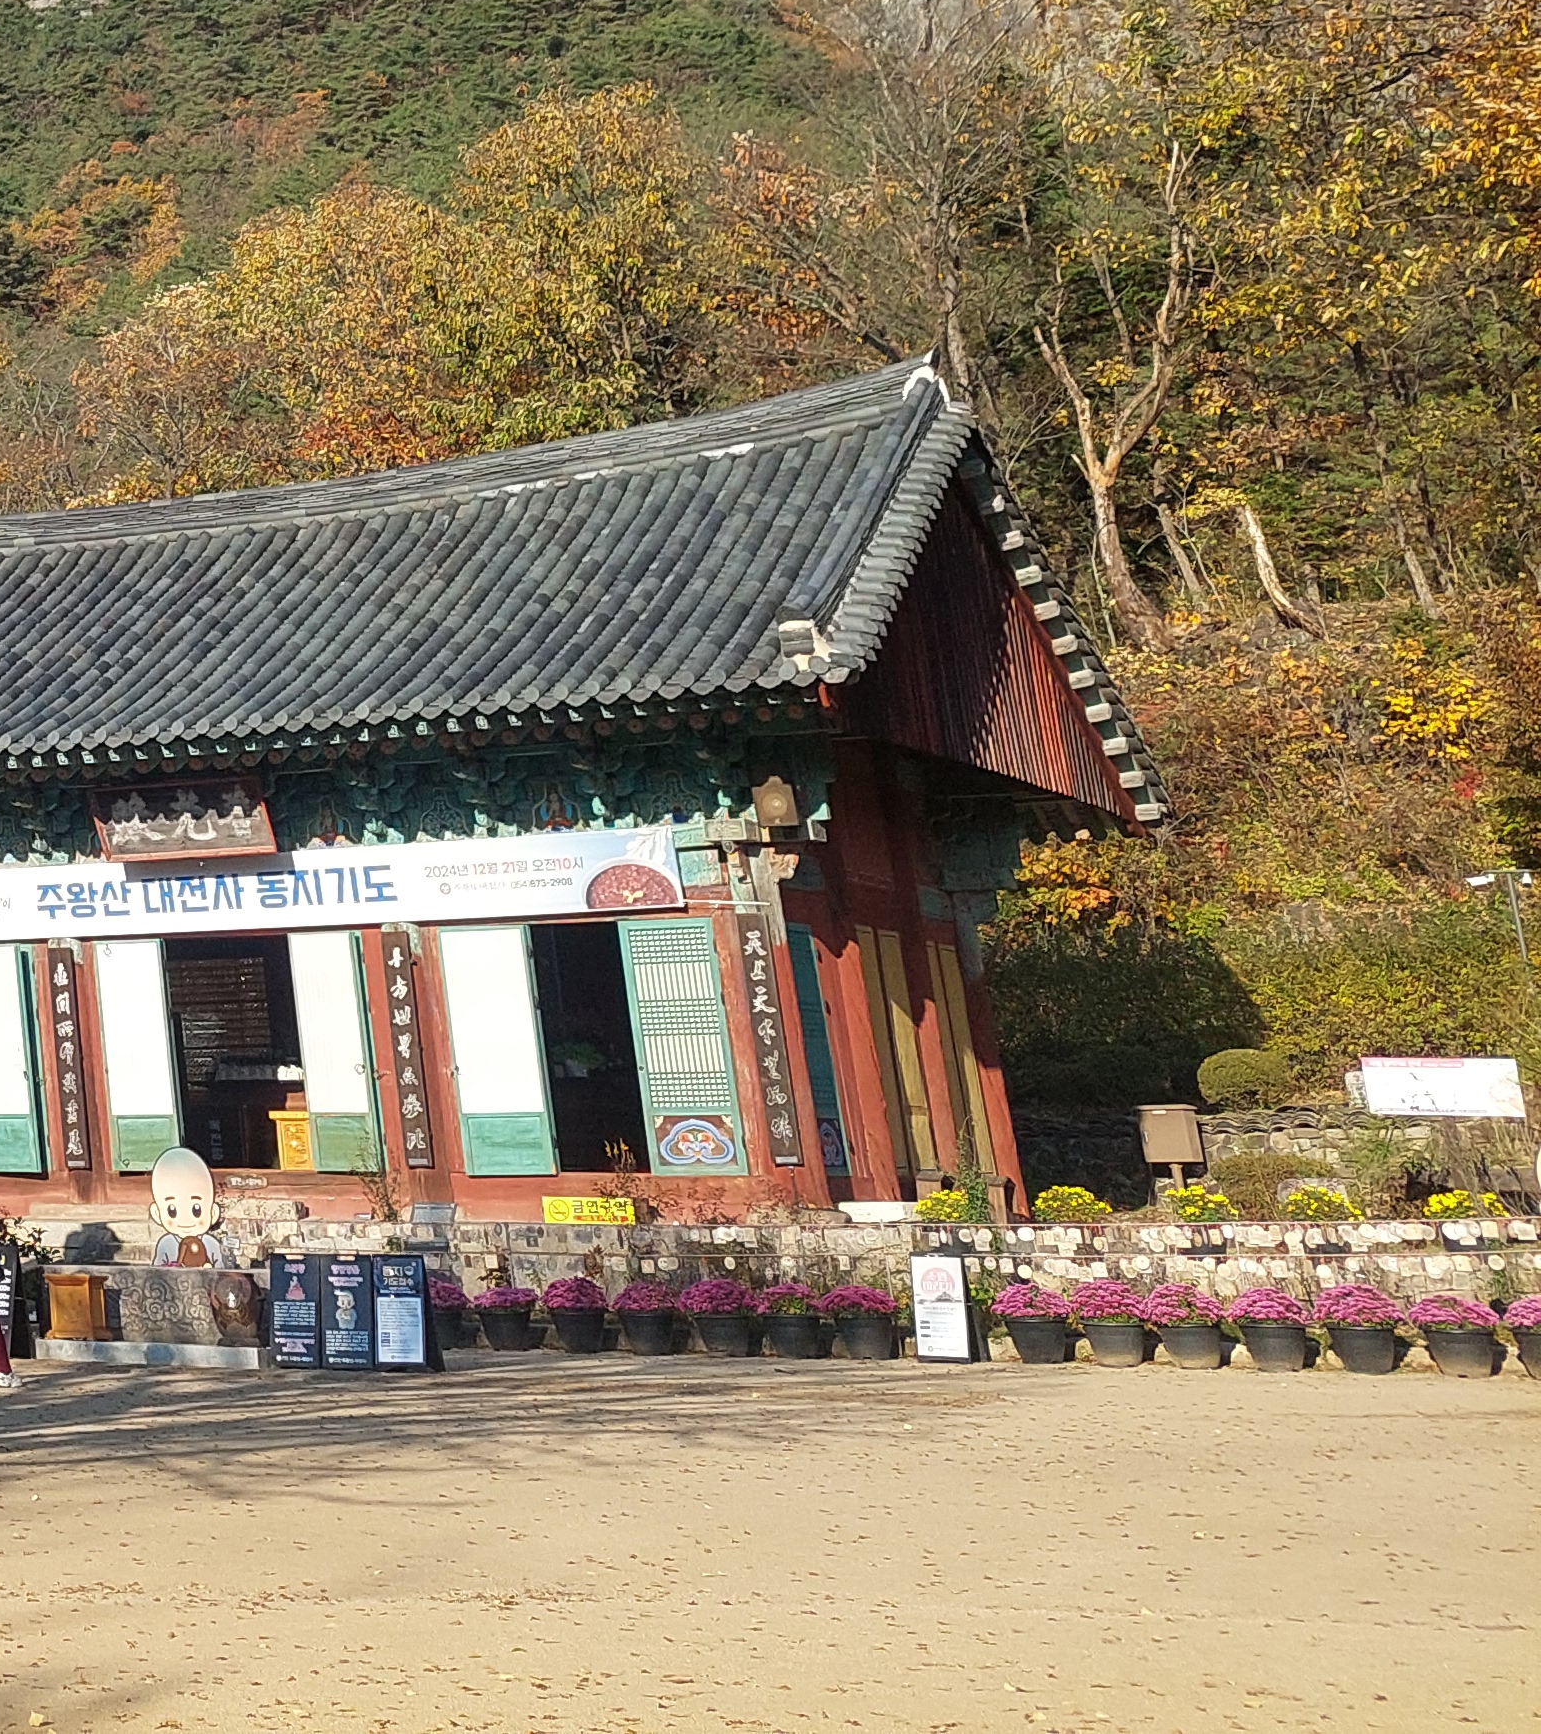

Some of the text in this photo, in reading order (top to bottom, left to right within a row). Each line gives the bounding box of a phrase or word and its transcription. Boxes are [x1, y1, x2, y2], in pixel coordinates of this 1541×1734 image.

[423, 864, 469, 878] 2024년
[473, 862, 498, 876] 12월
[501, 860, 528, 874] 21일
[36, 864, 399, 920] 주왕산 대전사 동지기도
